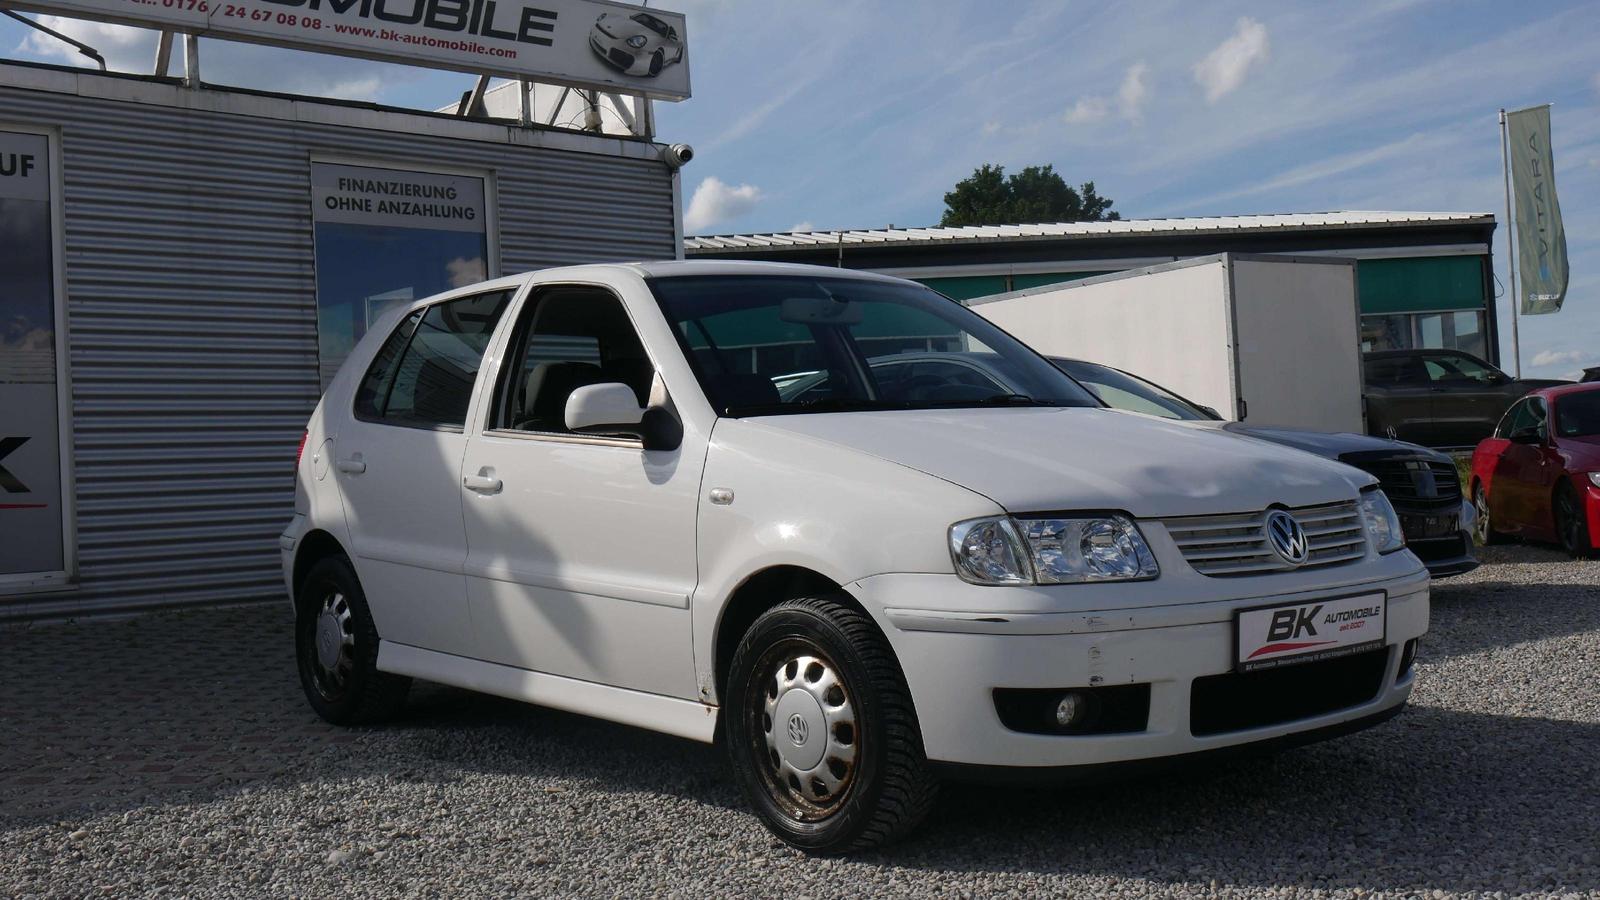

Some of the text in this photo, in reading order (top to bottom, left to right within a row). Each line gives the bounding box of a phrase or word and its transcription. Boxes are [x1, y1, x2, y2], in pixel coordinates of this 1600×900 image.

[223, 5, 247, 18] 24
[250, 9, 272, 21] 67
[276, 13, 297, 26] 08
[301, 17, 322, 30] 08
[334, 23, 518, 59] www.bk-automobile.com
[260, 0, 558, 46] OBILE
[338, 177, 458, 200] FINANZIERUNG
[1528, 131, 1549, 260] VITARA
[325, 196, 476, 220] OHNE ANZAHLUNG
[1266, 605, 1324, 642] BK
[1323, 606, 1380, 624] AUTOMOBILE
